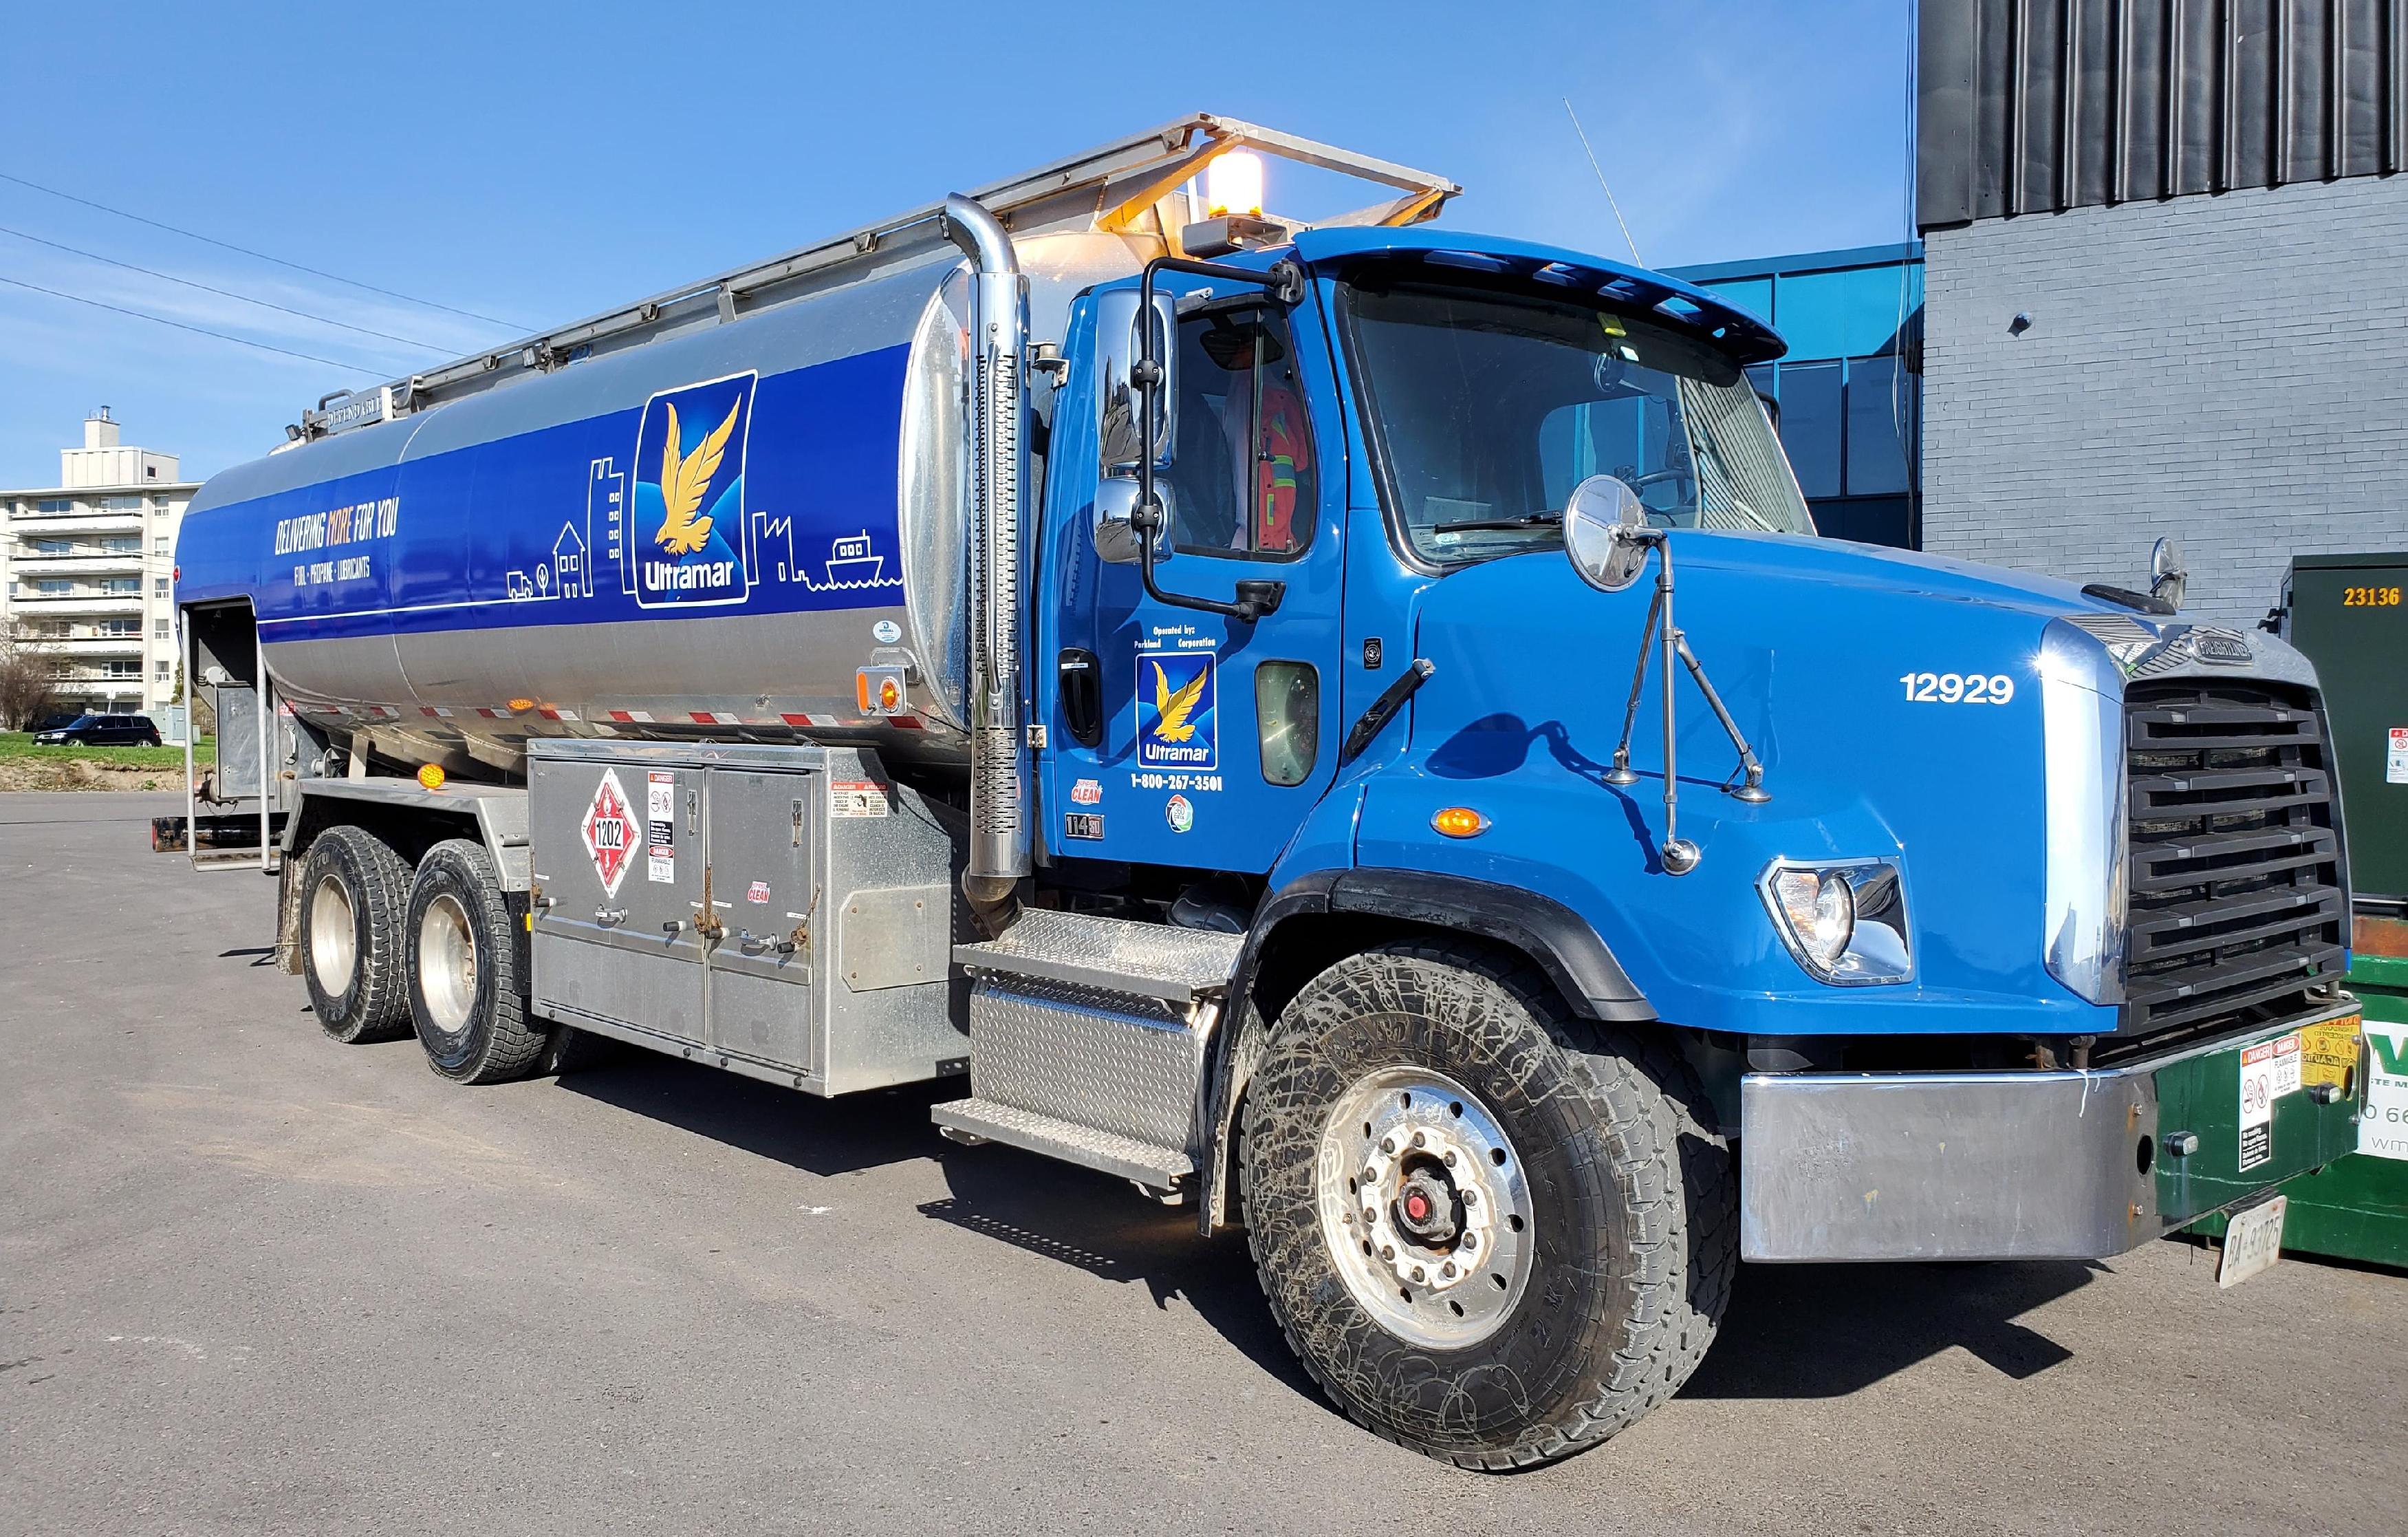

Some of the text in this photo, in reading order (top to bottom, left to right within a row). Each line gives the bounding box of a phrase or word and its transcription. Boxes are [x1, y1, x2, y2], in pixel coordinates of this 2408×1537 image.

[328, 396, 381, 427] DEPENDABLE
[275, 497, 400, 555] DELIVERING MORE FOR YOU
[294, 556, 370, 586] FUEL PROPANE LUBRICANTS
[645, 561, 734, 591] Ultramar
[2343, 588, 2399, 605] 23136
[1153, 625, 1182, 636] Operated
[1134, 637, 1215, 648] Parkland Corporation
[1900, 673, 2014, 705] 12929
[1145, 744, 1209, 762] Ultramar
[654, 774, 673, 782] DANGER
[1131, 773, 1222, 791] 1-800-267-3501
[1072, 788, 1100, 802] CLEAN
[596, 821, 622, 847] 1202
[1067, 816, 1100, 835] 114 SD
[749, 889, 769, 902] CLEAN
[2248, 1046, 2270, 1063] DANGER
